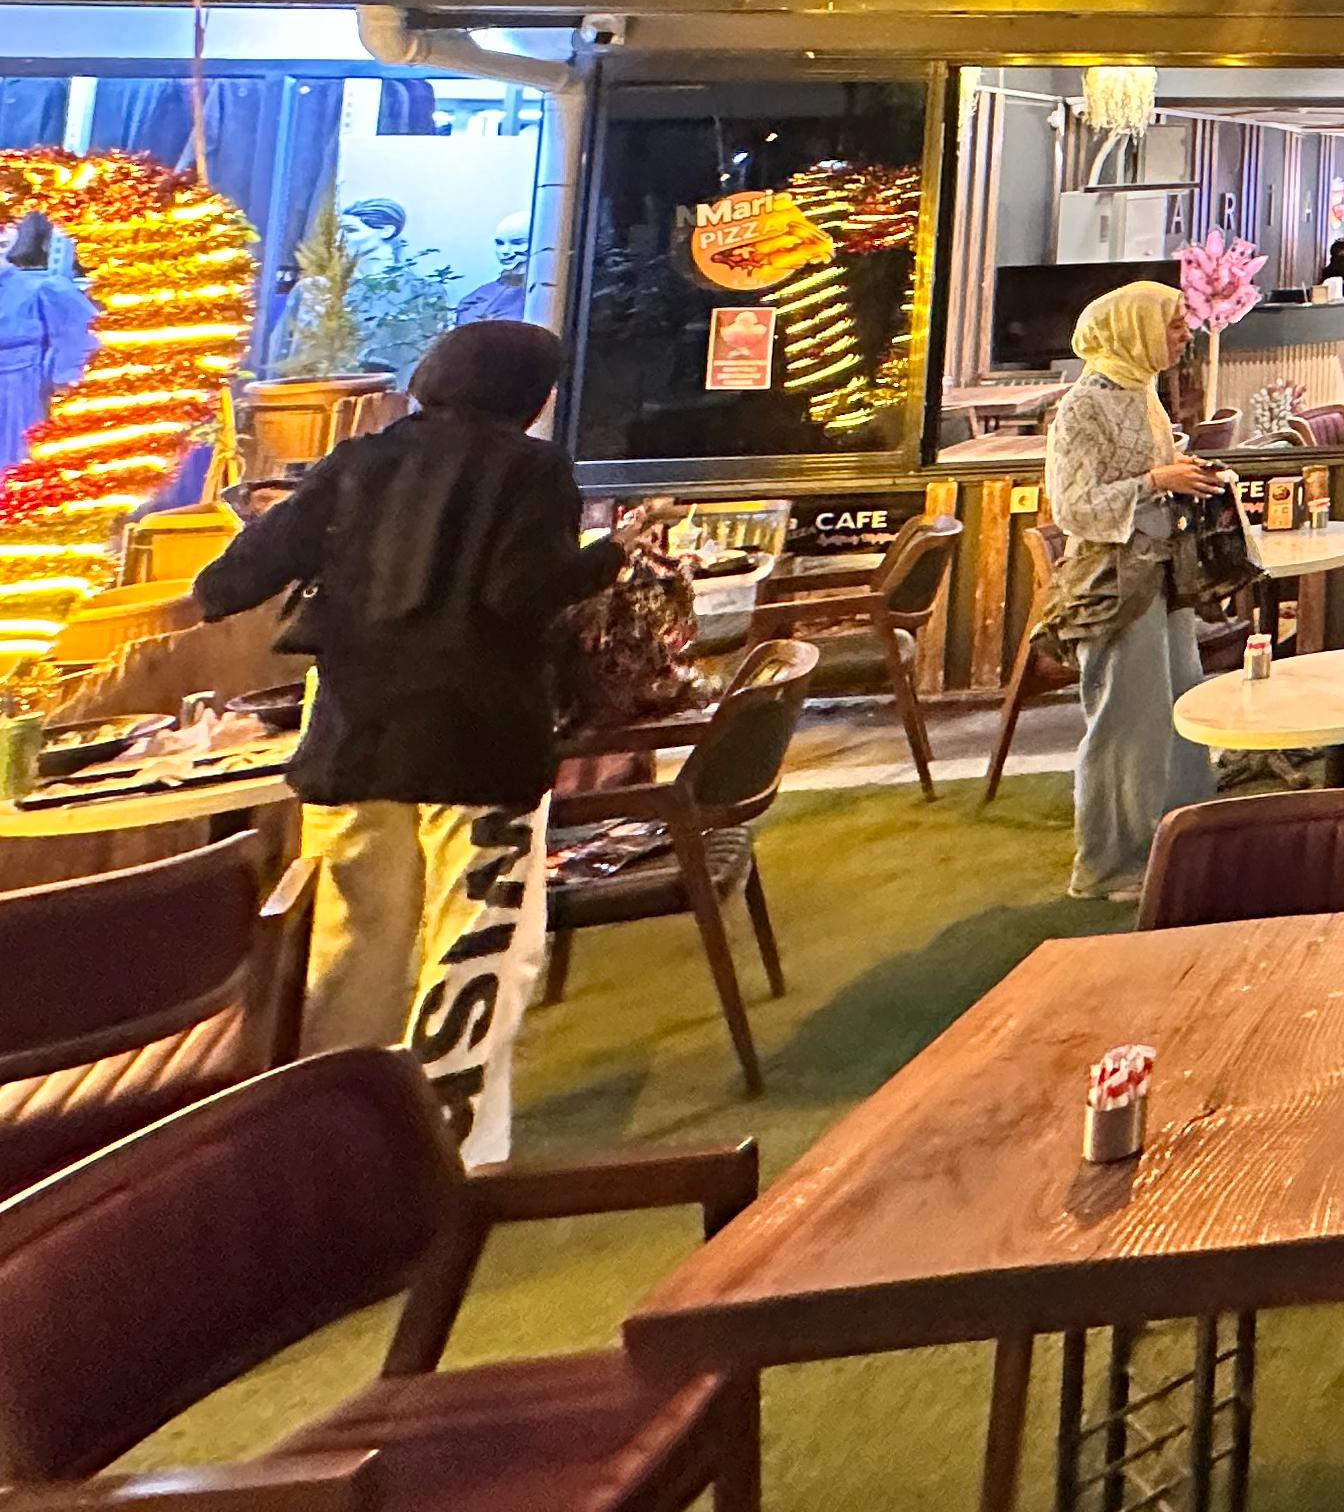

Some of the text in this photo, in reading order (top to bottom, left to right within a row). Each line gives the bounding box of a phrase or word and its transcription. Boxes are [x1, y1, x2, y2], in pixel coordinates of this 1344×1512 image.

[696, 190, 794, 227] Maria
[700, 219, 783, 250] PIZZA
[815, 510, 888, 531] CAFE
